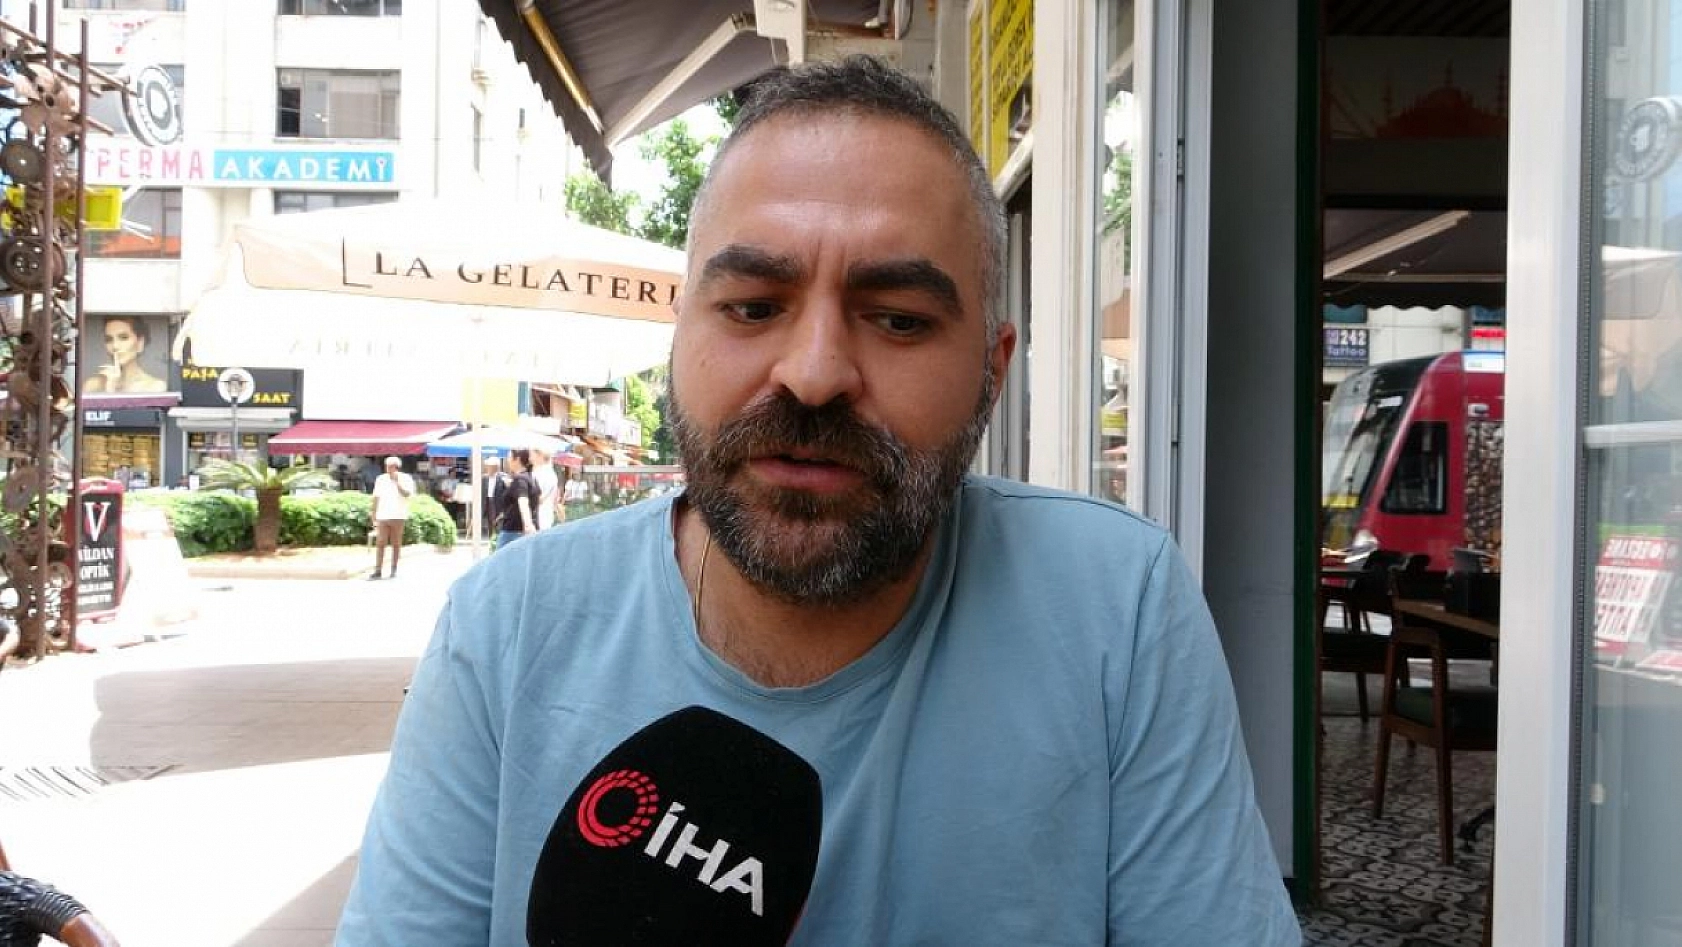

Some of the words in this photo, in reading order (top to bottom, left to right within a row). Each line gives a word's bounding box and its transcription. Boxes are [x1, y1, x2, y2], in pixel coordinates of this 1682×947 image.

[96, 149, 205, 180] PERMA
[374, 251, 434, 280] LA
[457, 259, 679, 307] GELATERI
[252, 391, 291, 404] SAAT
[84, 502, 112, 542] V
